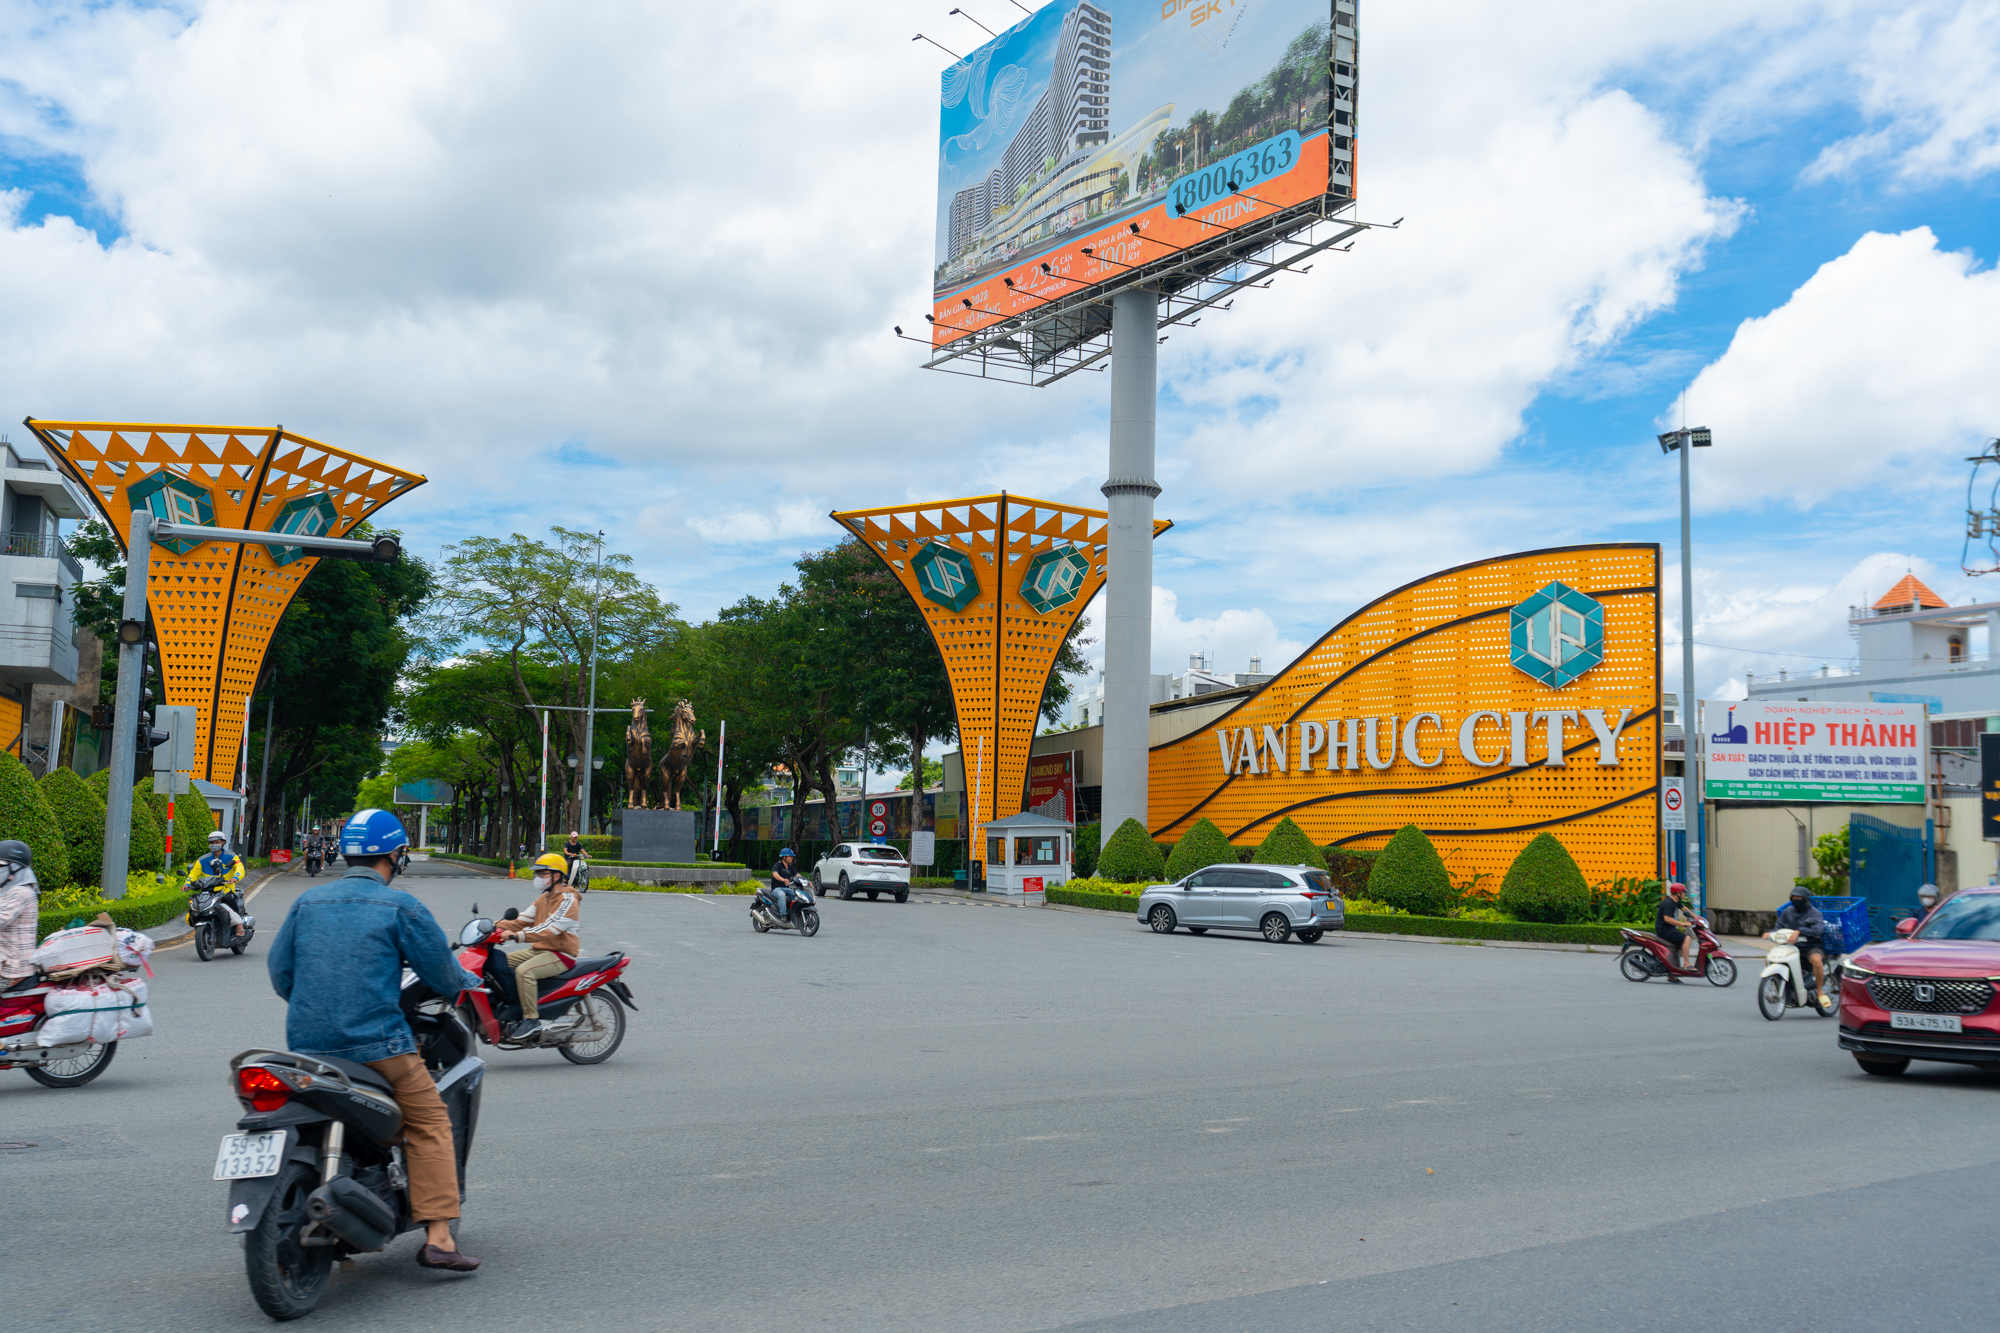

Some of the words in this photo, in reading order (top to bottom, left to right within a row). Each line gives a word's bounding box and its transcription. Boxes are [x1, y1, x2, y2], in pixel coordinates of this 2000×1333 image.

[1172, 137, 1292, 208] 18006363
[1201, 194, 1258, 231] HOTLINE
[1110, 234, 1116, 242] &
[1128, 238, 1142, 251] TIỆN
[1099, 242, 1126, 272] 100
[1128, 250, 1140, 262] ÍCH
[1030, 256, 1060, 289] 296
[1035, 279, 1068, 298] SHOPHOUSE
[939, 308, 952, 320] BÀN
[952, 303, 967, 314] GIA
[971, 290, 988, 306] 2028
[1799, 706, 1833, 715] NGHIỆP
[1835, 708, 1860, 716] GẠCH
[1216, 723, 1290, 775] VAN
[1299, 712, 1445, 773] PHUC
[1458, 708, 1633, 769] CITY
[1755, 717, 1816, 750] HIỆP
[1826, 718, 1916, 748] THÀNH
[1712, 751, 1726, 762] SẢN
[1748, 754, 1767, 764] GẠCH
[1032, 764, 1054, 778] DIAMOND
[1054, 763, 1064, 775] SKY
[874, 806, 882, 814] 30
[1896, 1016, 1956, 1030] 93A-475.12
[229, 1134, 274, 1155] 59-S1
[220, 1154, 276, 1176] 133.52
